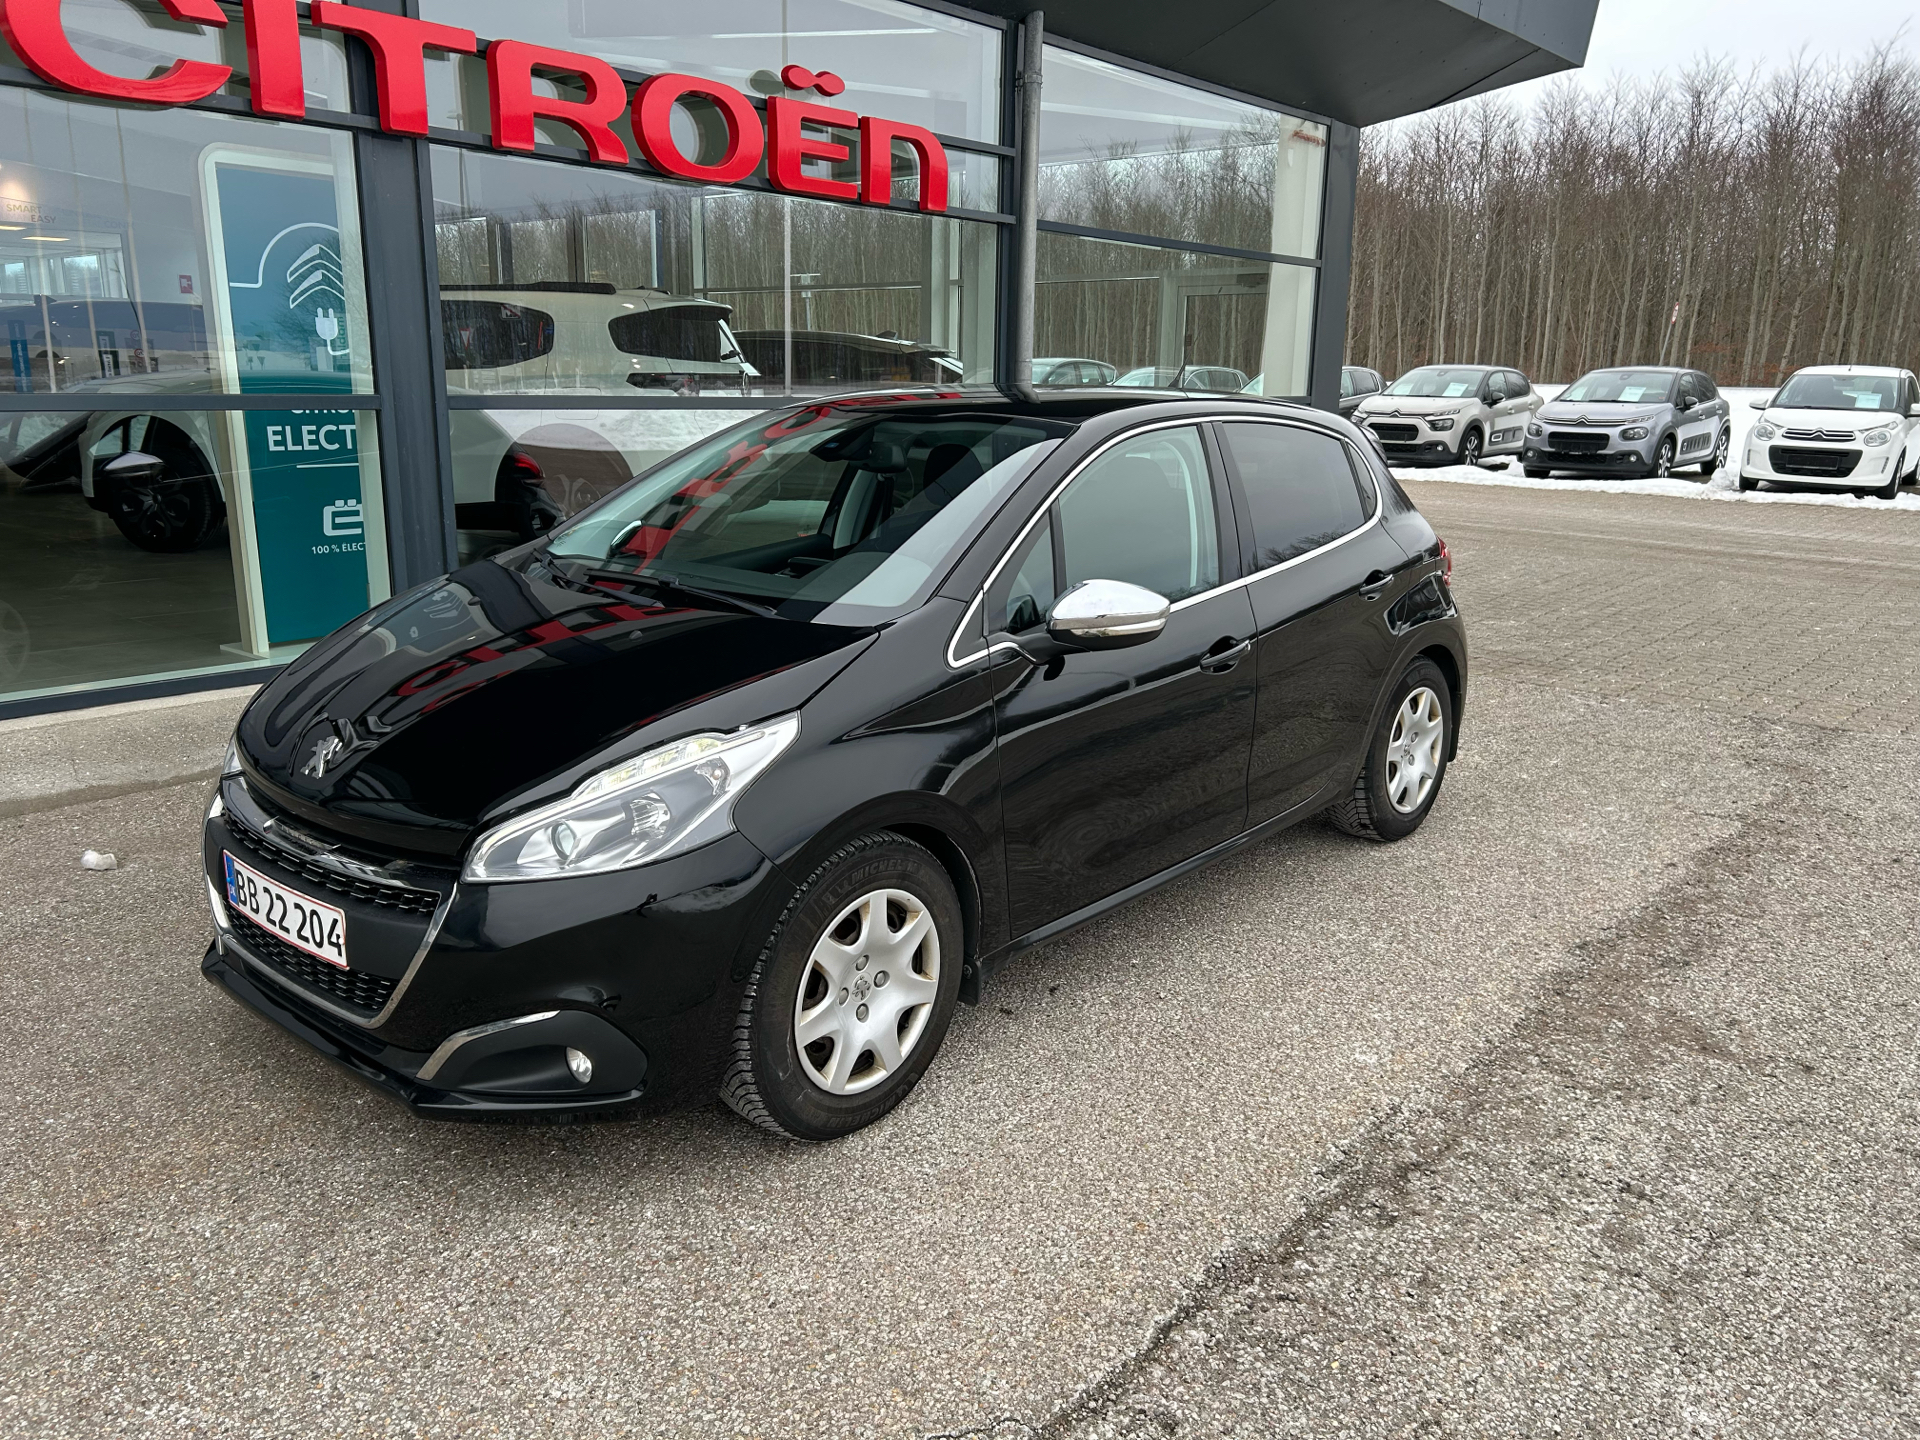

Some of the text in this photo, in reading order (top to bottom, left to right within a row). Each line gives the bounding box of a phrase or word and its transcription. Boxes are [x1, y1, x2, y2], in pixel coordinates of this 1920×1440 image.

[6, 204, 42, 214] SMART
[31, 215, 56, 224] EASY
[311, 545, 330, 554] 100
[331, 544, 340, 553] %
[850, 858, 919, 885] MICHELIN
[235, 868, 343, 958] BB 22 204
